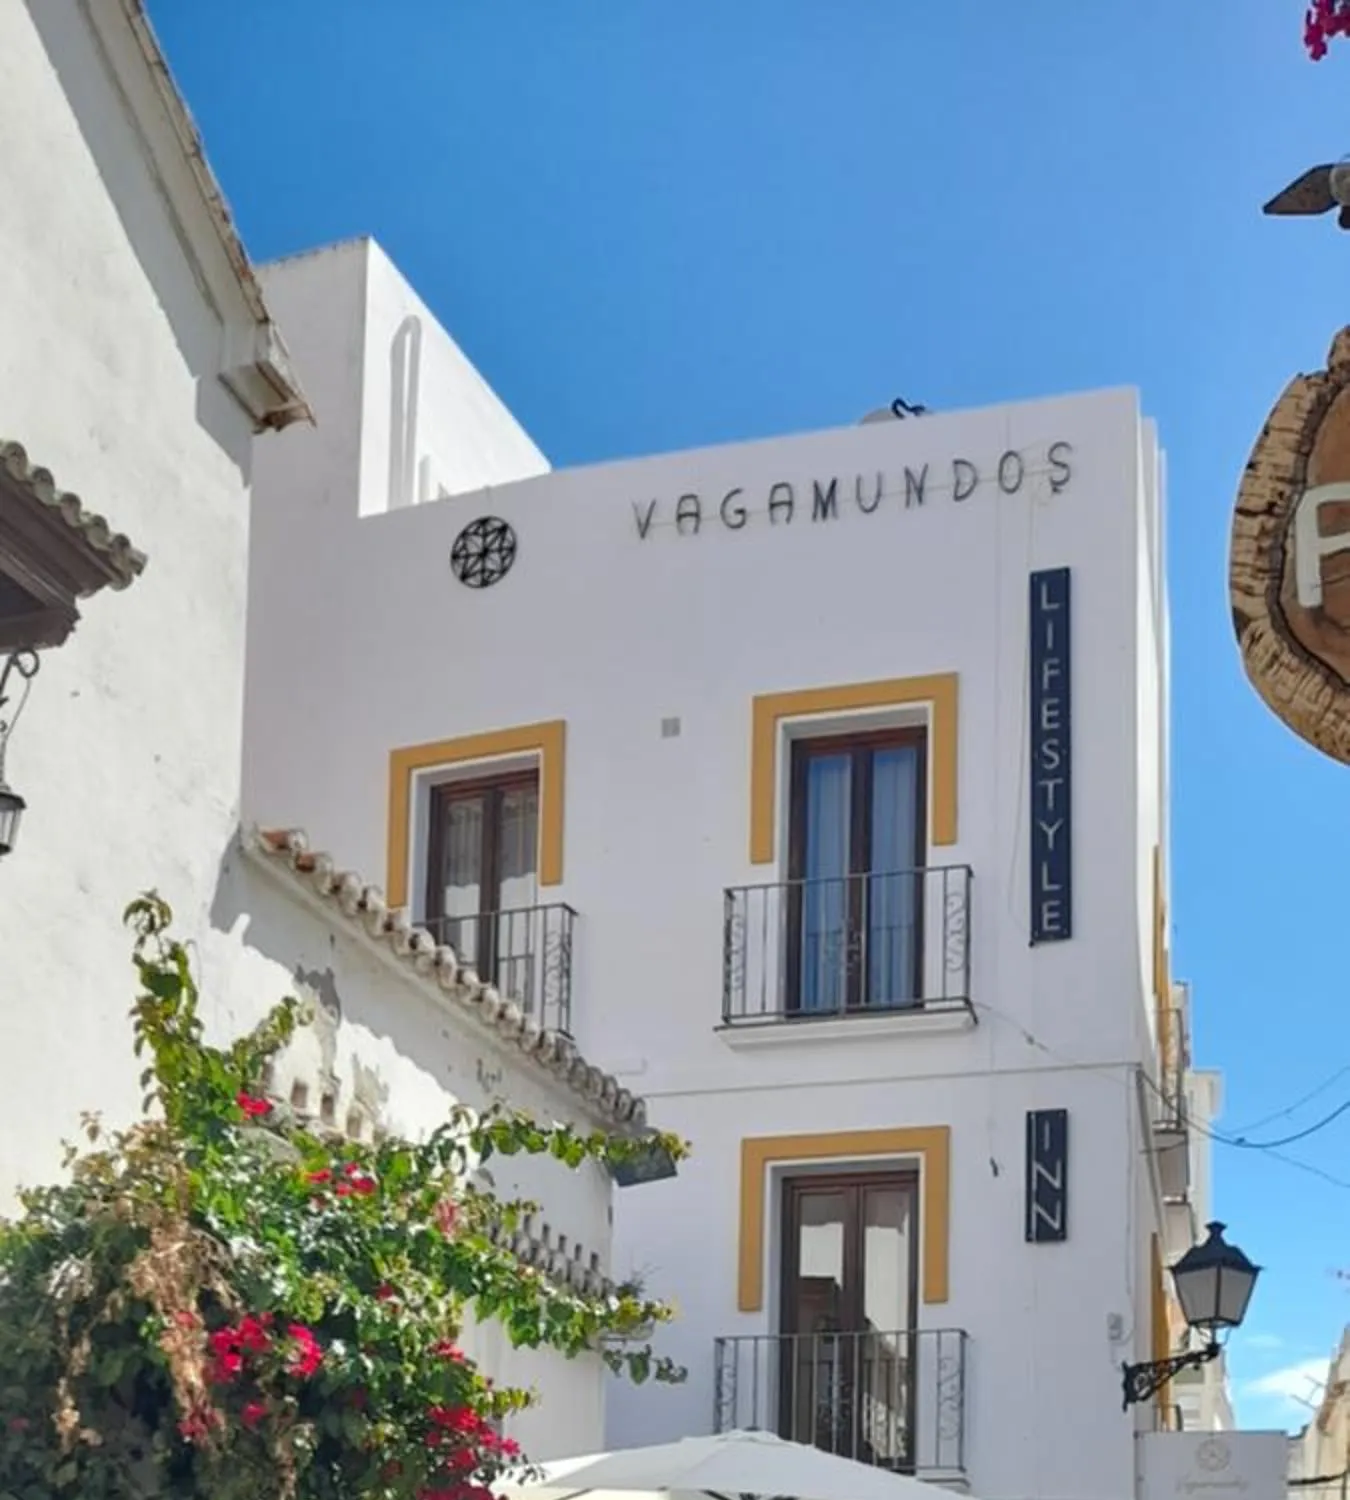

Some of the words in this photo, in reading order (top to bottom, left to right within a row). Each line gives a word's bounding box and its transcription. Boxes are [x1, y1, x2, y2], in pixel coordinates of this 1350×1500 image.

[632, 441, 1074, 540] VAGAMUNDOS
[1038, 580, 1064, 933] LIFESTYLE
[1031, 1118, 1063, 1232] INN
